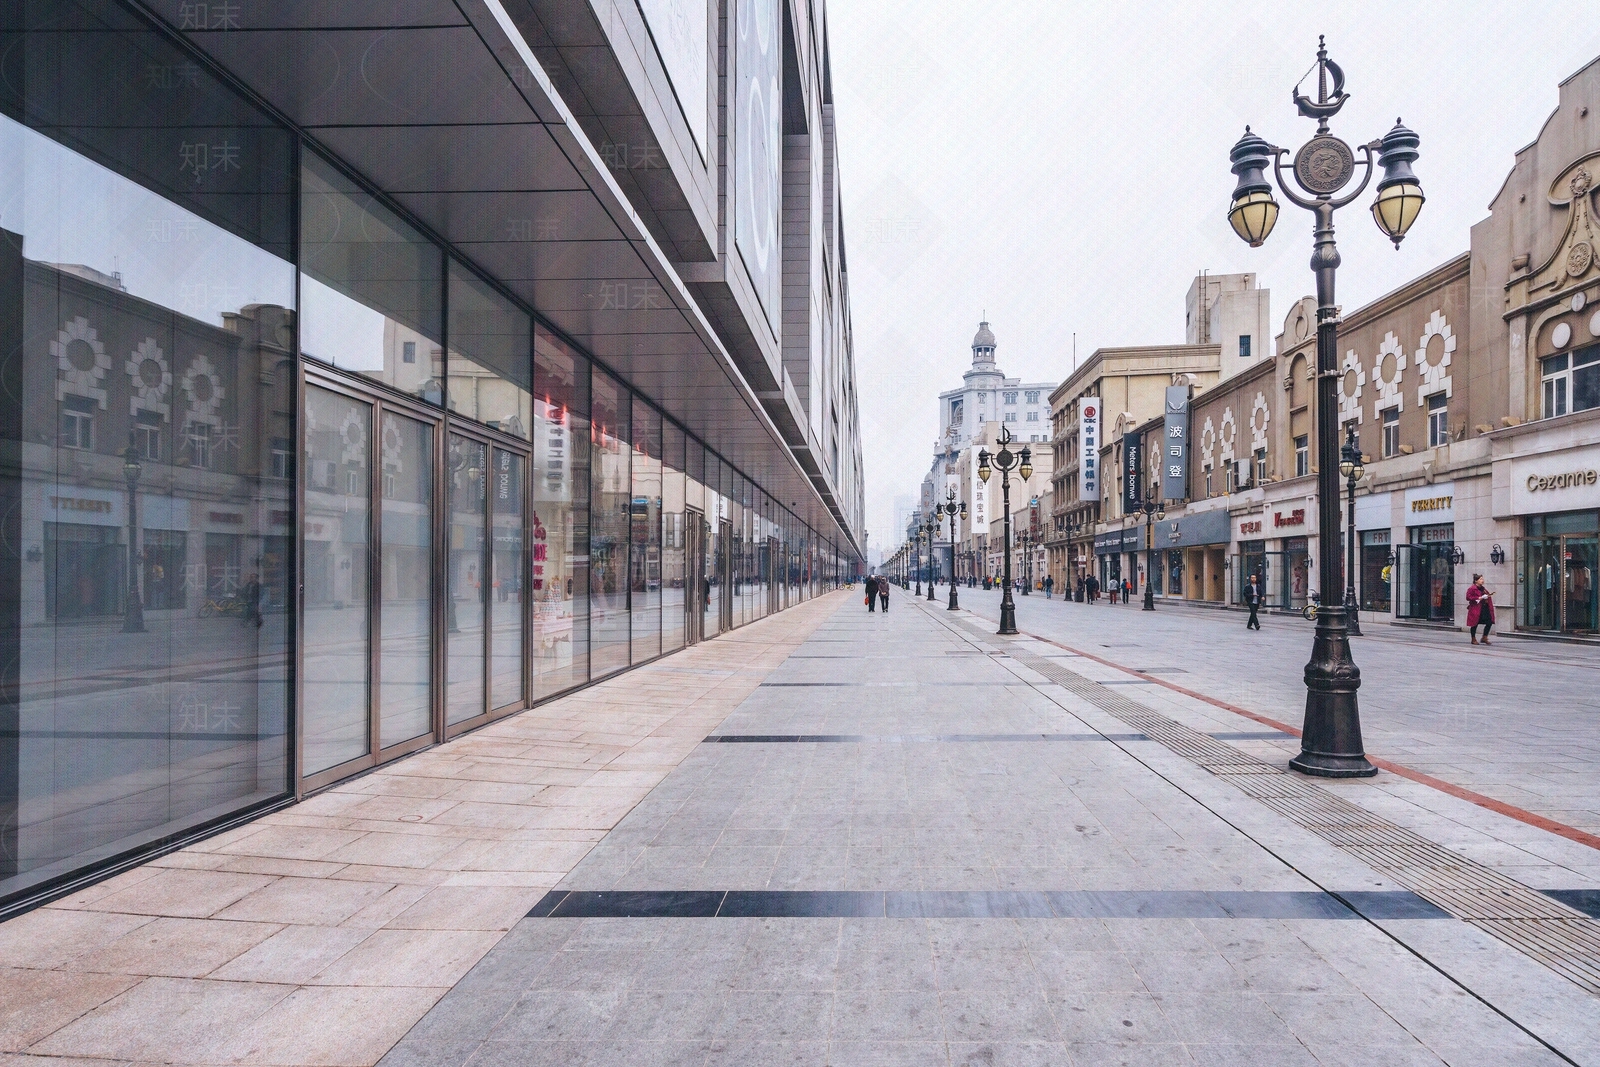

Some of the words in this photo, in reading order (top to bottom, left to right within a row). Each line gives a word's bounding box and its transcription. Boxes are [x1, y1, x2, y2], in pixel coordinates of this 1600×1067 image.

[1169, 426, 1183, 478] 波司登
[1526, 468, 1598, 492] Cezanne
[1411, 496, 1453, 512] FERRITY
[1373, 531, 1389, 543] FRT
